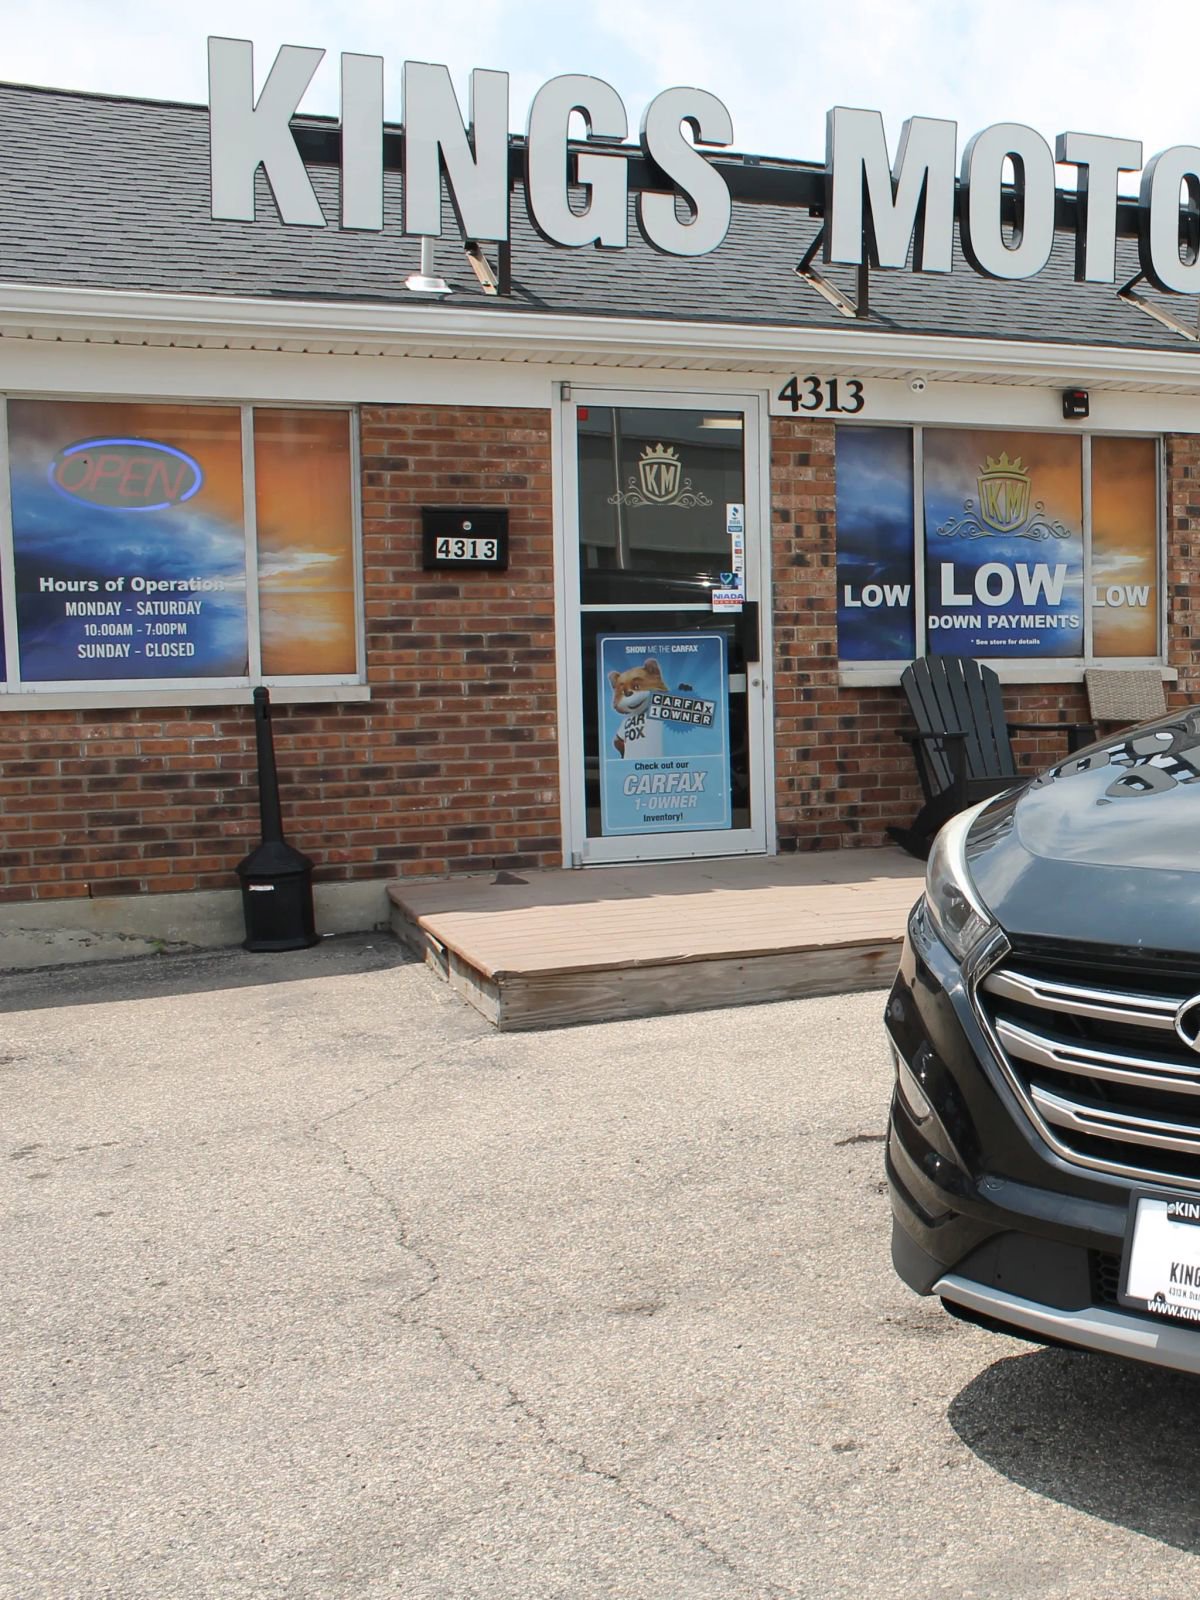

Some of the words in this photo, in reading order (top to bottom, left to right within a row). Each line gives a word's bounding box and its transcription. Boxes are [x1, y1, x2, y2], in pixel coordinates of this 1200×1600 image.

[208, 36, 734, 257] KINGS
[778, 376, 865, 413] 4313
[54, 451, 189, 499] OPEN
[645, 464, 676, 496] KM
[984, 480, 1025, 524] KM
[437, 538, 497, 560] 4313
[39, 577, 99, 592] Hours
[105, 577, 125, 592] of
[131, 577, 225, 595] Operation
[940, 563, 1067, 606] LOW
[844, 584, 911, 607] LOW
[1093, 585, 1149, 607] LOW
[65, 601, 122, 617] MONDAY
[136, 600, 202, 616] SATURDAY
[84, 623, 133, 637] 10:00AM
[145, 622, 187, 635] 7:00PM
[928, 615, 981, 630] DOWN
[988, 614, 1080, 629] PAYMENTS
[77, 643, 131, 659] SUNDAY
[145, 643, 195, 658] CLOSED
[625, 645, 646, 654] SHOW
[647, 645, 658, 654] ME
[659, 645, 671, 653] THE
[671, 644, 699, 653] CARFAX
[653, 695, 713, 714] CARFAX
[624, 713, 645, 730] CAR
[624, 726, 646, 741] FOX
[634, 762, 659, 771] Check
[661, 762, 674, 770] out
[676, 761, 689, 769] our
[623, 771, 708, 796] CARFAX
[635, 795, 698, 810] 1-OWNER
[643, 812, 684, 823] Inventory!
